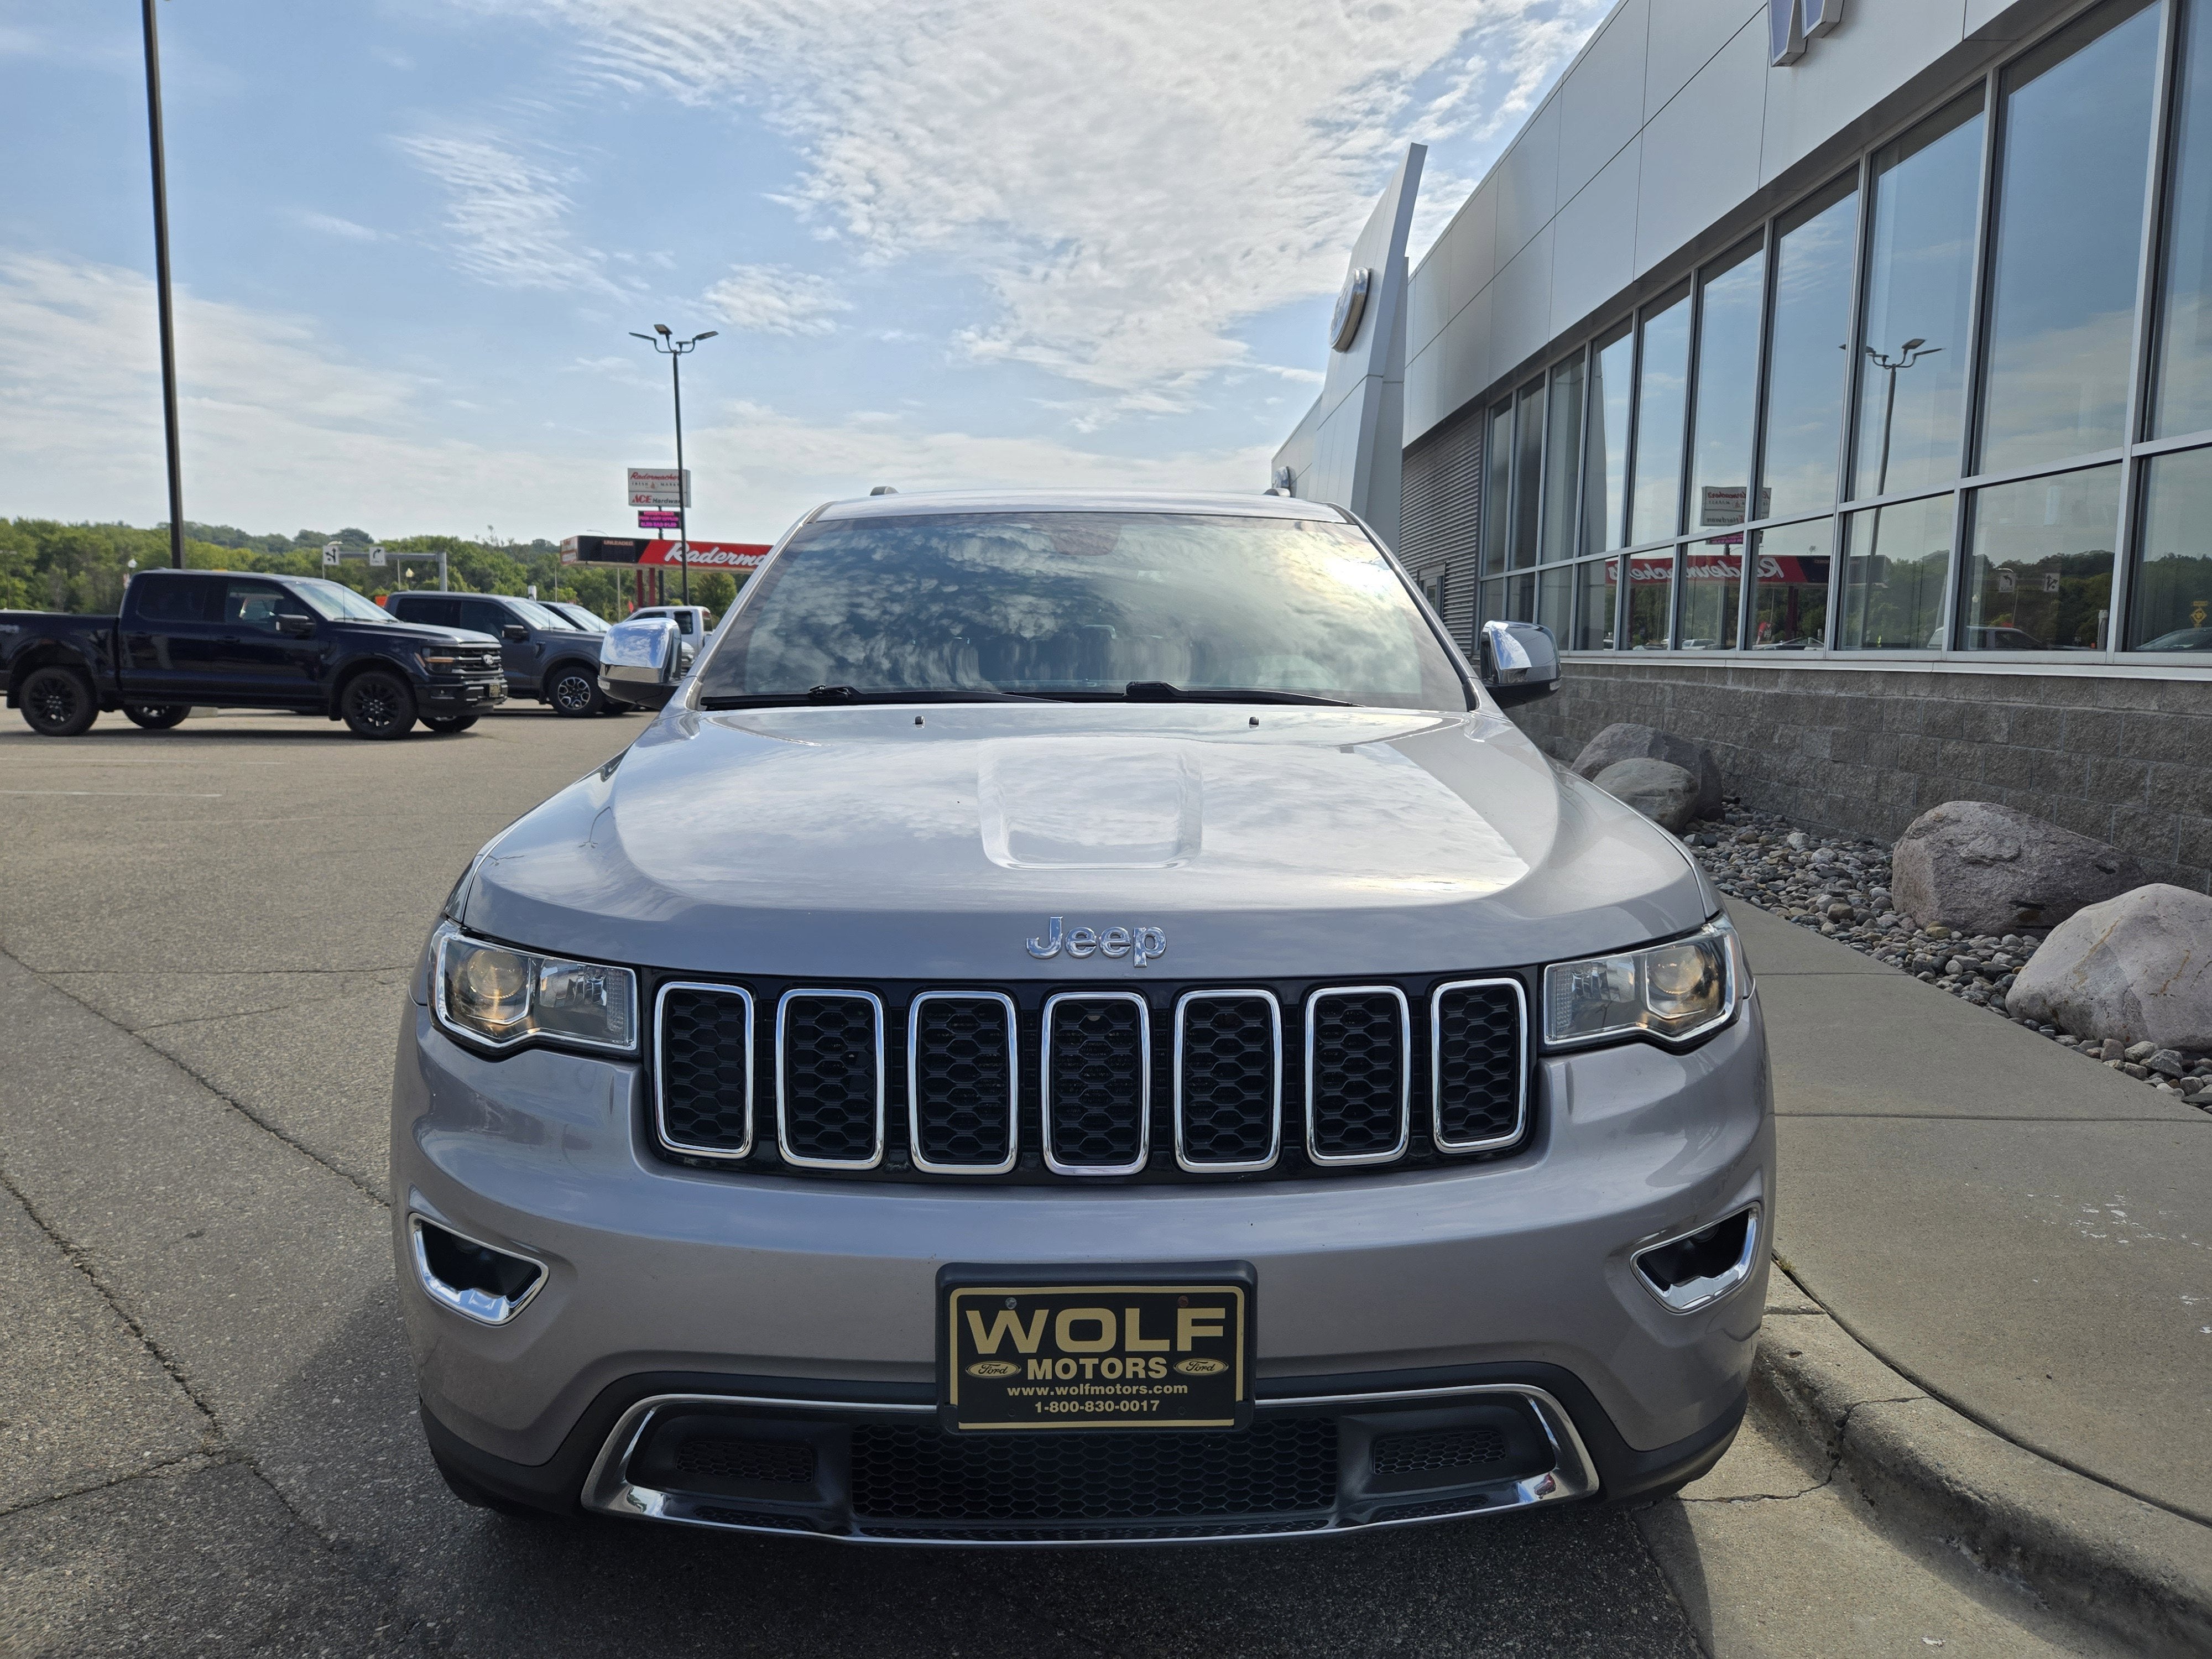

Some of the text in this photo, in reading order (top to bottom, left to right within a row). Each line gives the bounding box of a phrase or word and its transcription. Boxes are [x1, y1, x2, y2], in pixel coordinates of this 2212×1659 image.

[630, 472, 679, 481] Radermache
[632, 494, 652, 503] ACE
[664, 542, 768, 566] Raderma
[1026, 916, 1166, 968] Jeep
[966, 1308, 1225, 1354] WOLF
[1027, 1357, 1167, 1380] MOTORS
[1006, 1383, 1188, 1396] www.wolfmotors.com
[1035, 1400, 1160, 1413] 1-800-830-0017
